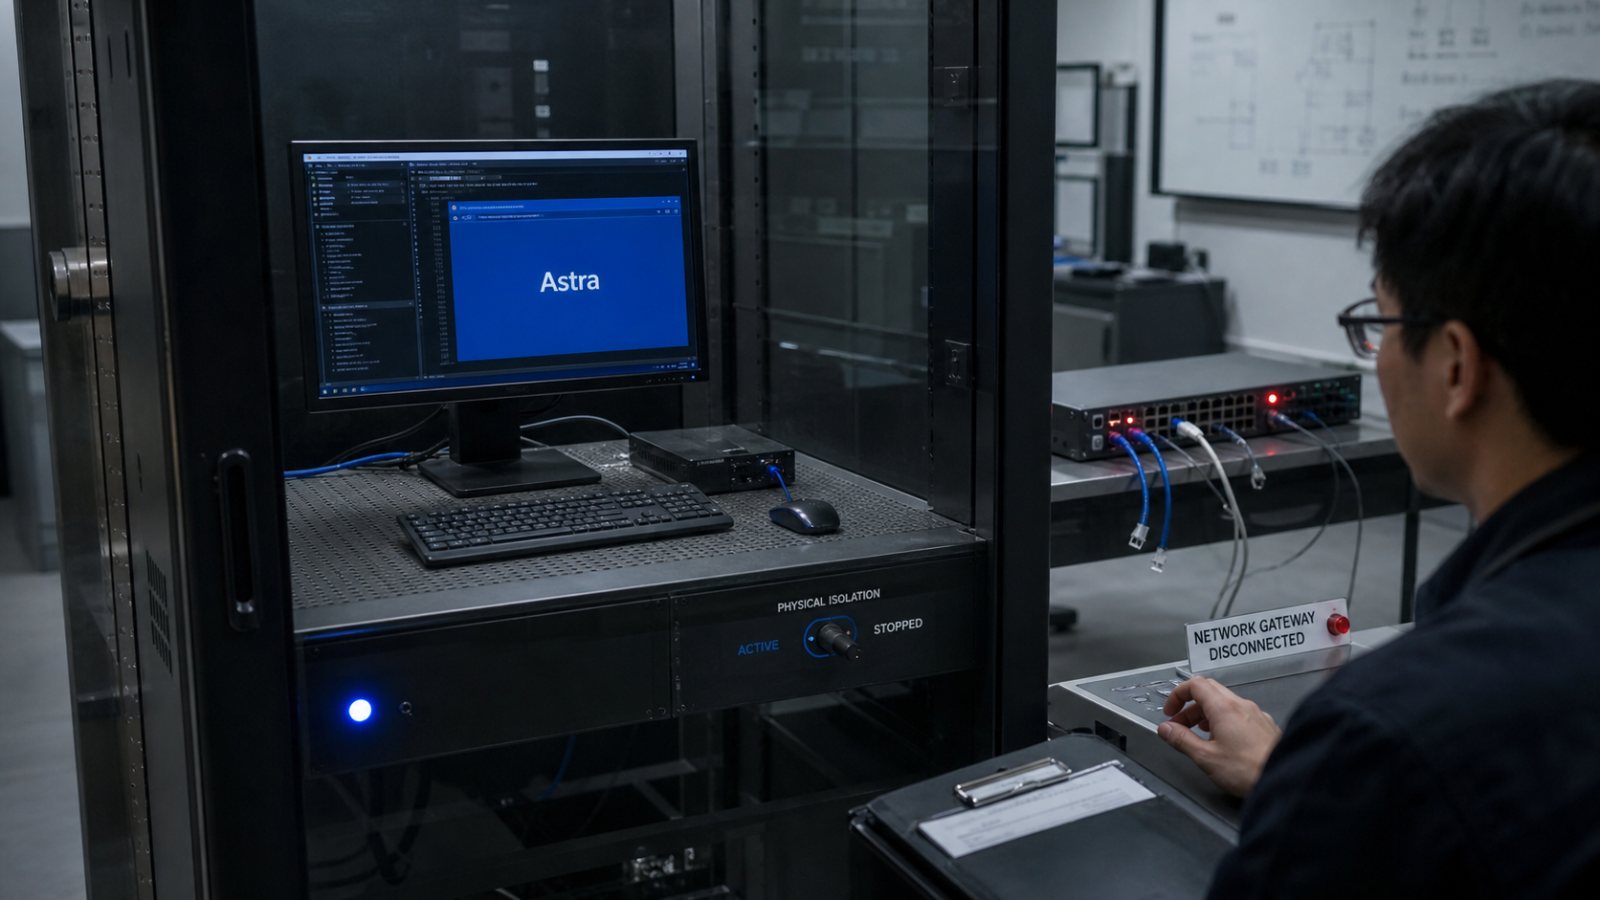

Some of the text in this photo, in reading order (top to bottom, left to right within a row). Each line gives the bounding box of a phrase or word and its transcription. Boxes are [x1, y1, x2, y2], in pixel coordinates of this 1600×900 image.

[540, 271, 600, 292] Astra
[777, 588, 881, 612] PHYSICAL ISOLATION
[873, 618, 923, 635] STOPPED
[1194, 611, 1316, 645] NETWORK GATEWAY
[737, 640, 779, 655] ACTIVE
[1209, 631, 1305, 661] DISCONNECTED
